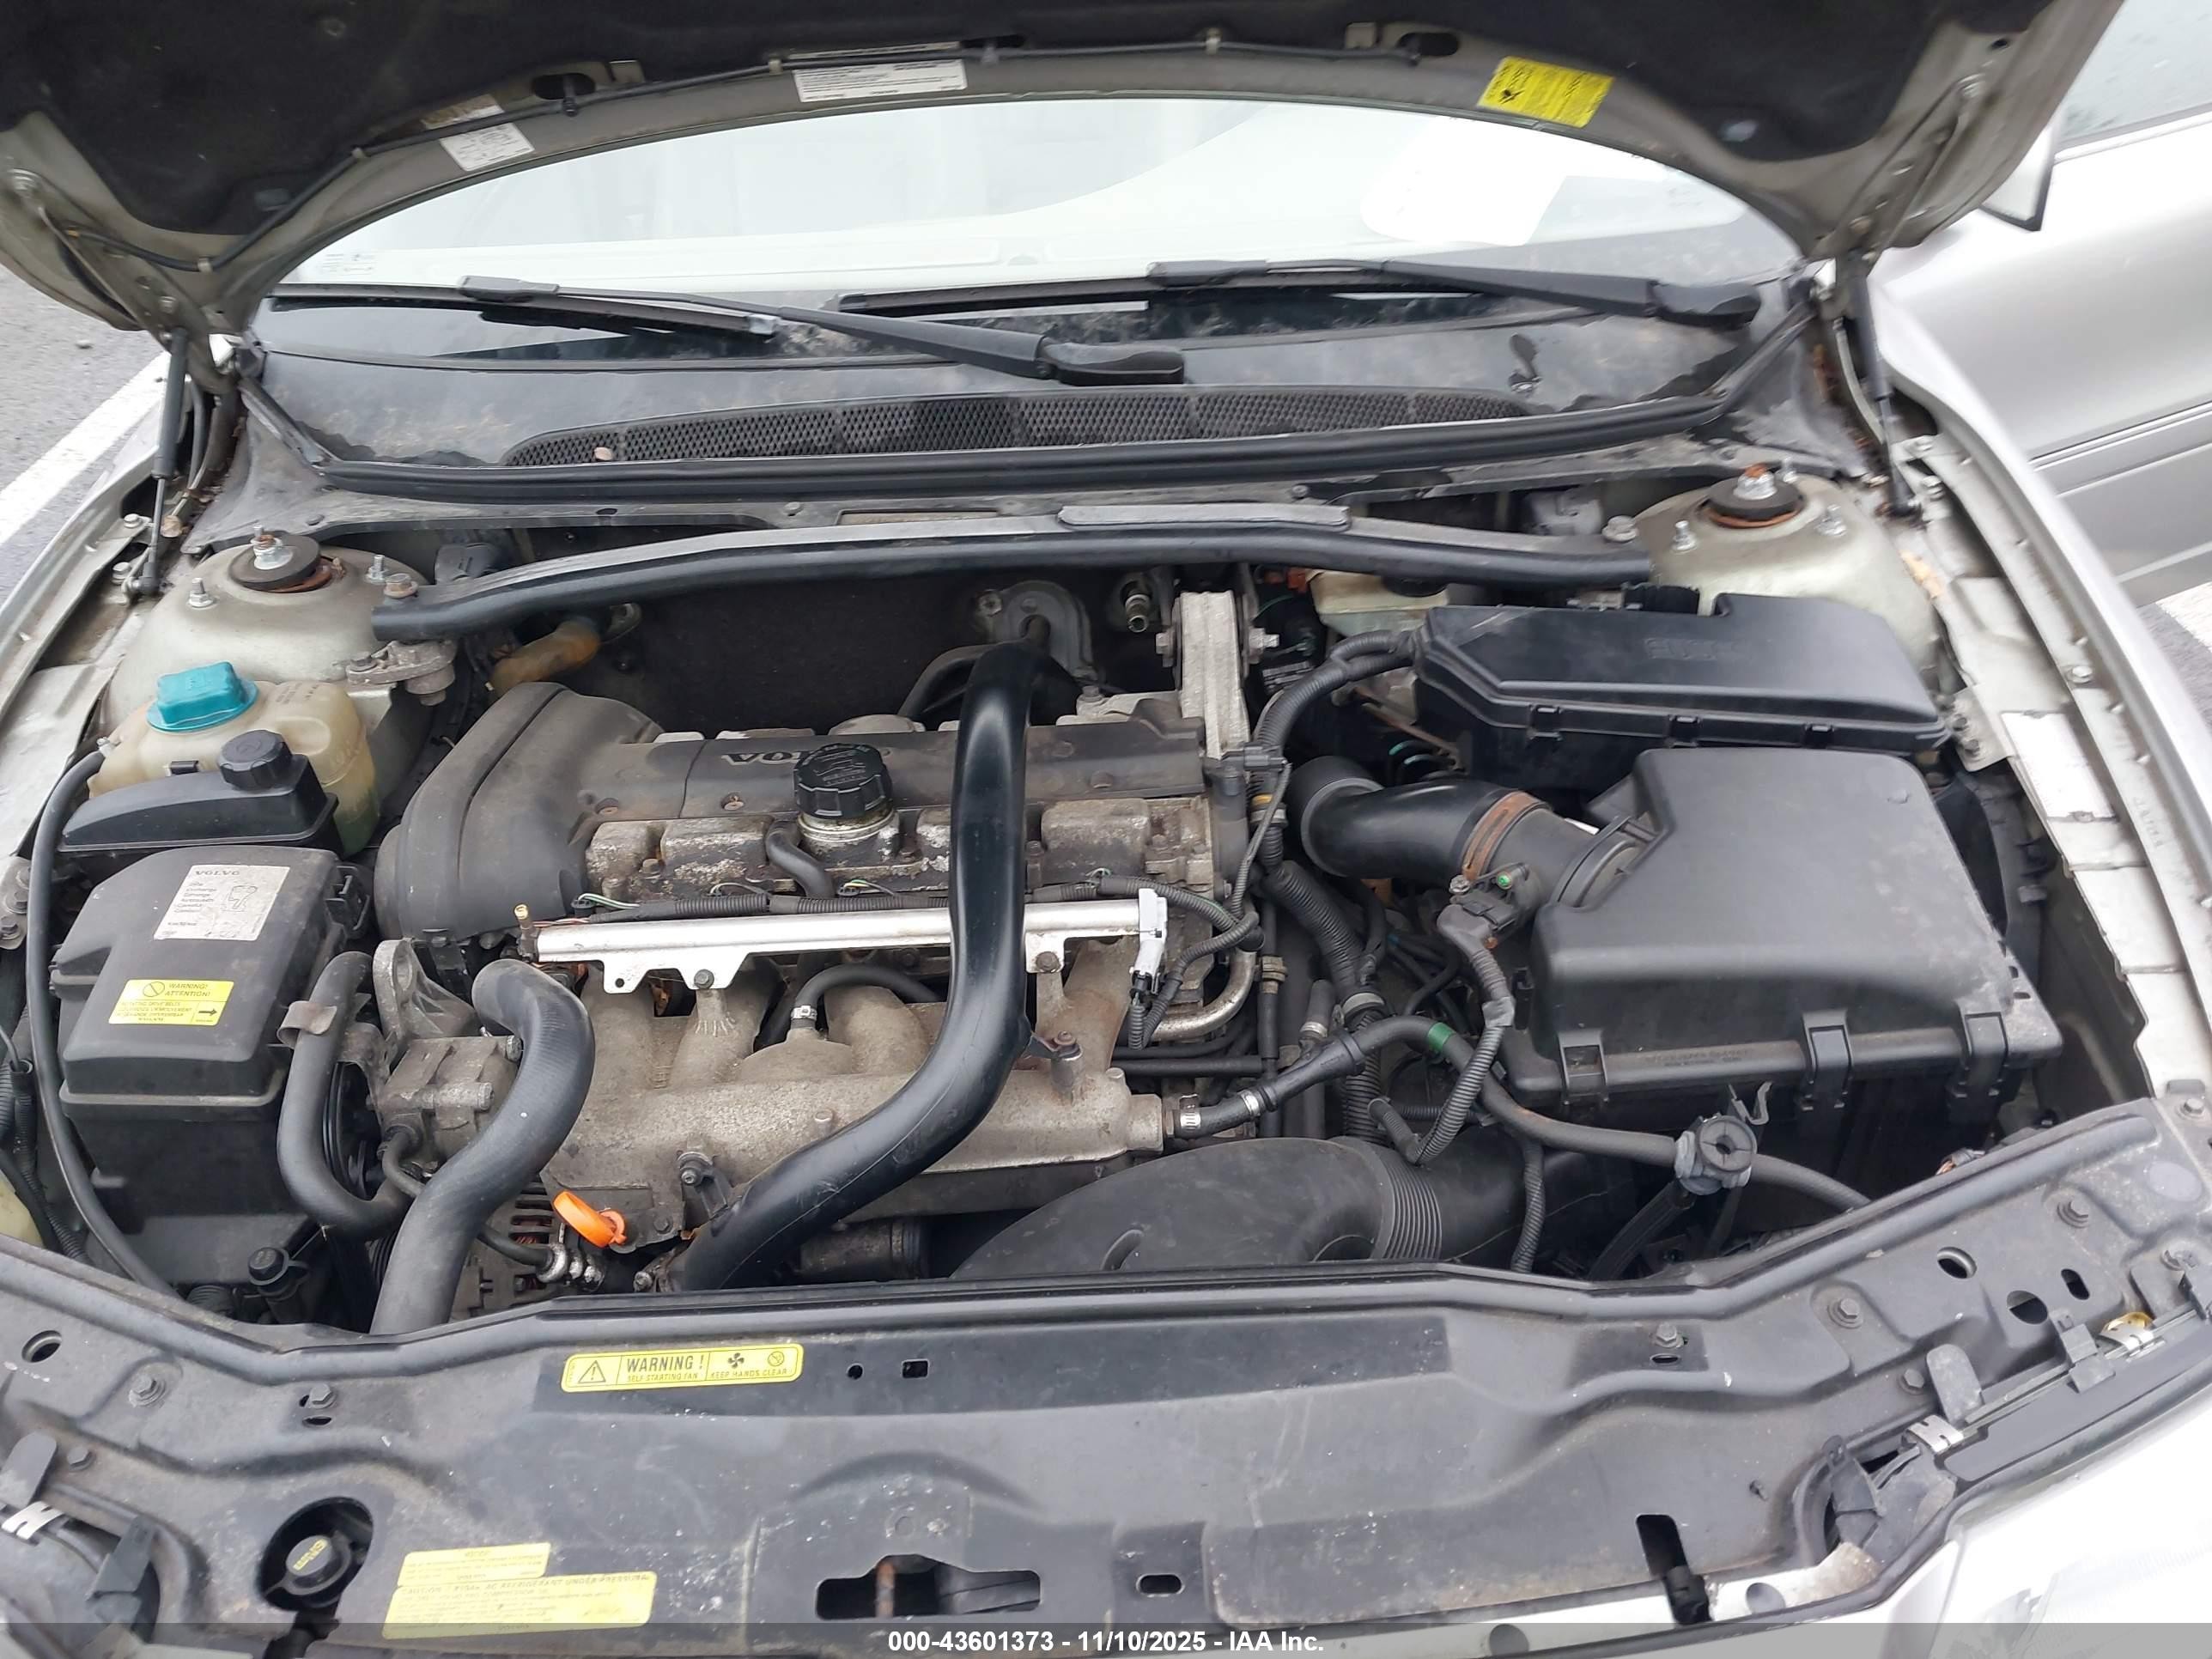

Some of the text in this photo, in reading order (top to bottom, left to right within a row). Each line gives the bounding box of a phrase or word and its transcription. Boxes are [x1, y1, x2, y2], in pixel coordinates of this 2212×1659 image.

[627, 1356, 694, 1373] WARNING
[646, 1372, 682, 1382] STARTING
[684, 1372, 698, 1381] FAN
[711, 1368, 787, 1379] KEEP HANDS CLEAR
[565, 1576, 596, 1585] UNDER
